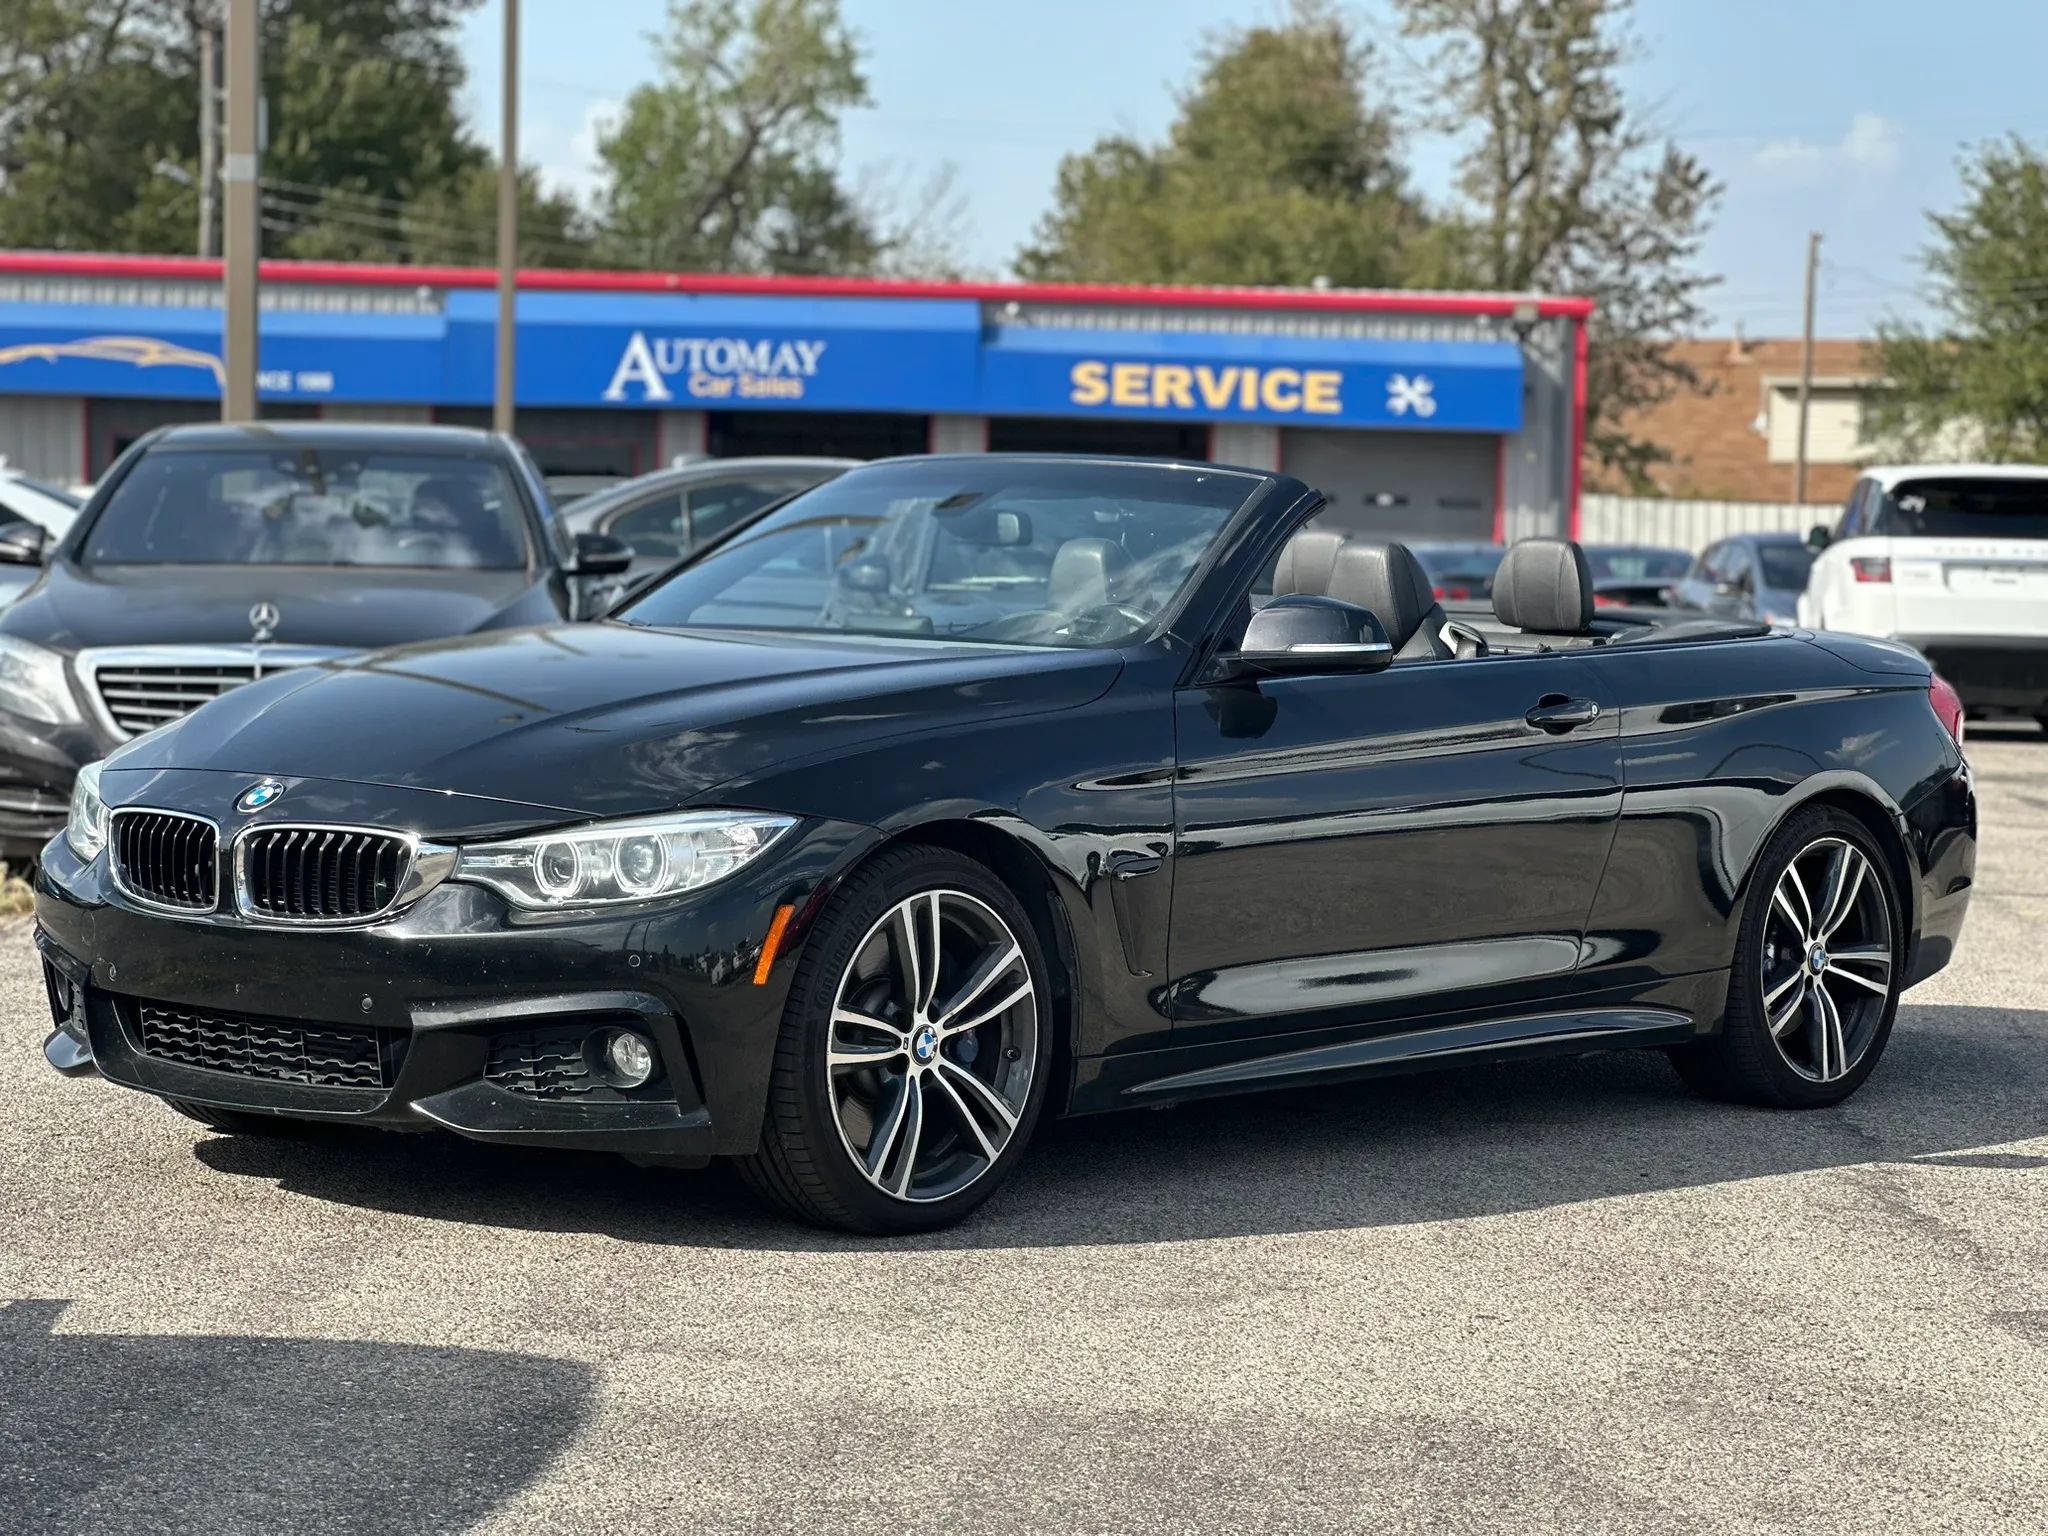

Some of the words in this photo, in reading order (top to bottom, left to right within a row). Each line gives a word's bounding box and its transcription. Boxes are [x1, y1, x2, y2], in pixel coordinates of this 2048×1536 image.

[688, 373, 733, 398] Car
[739, 373, 804, 399] Sales
[1071, 361, 1343, 414] SERVICE
